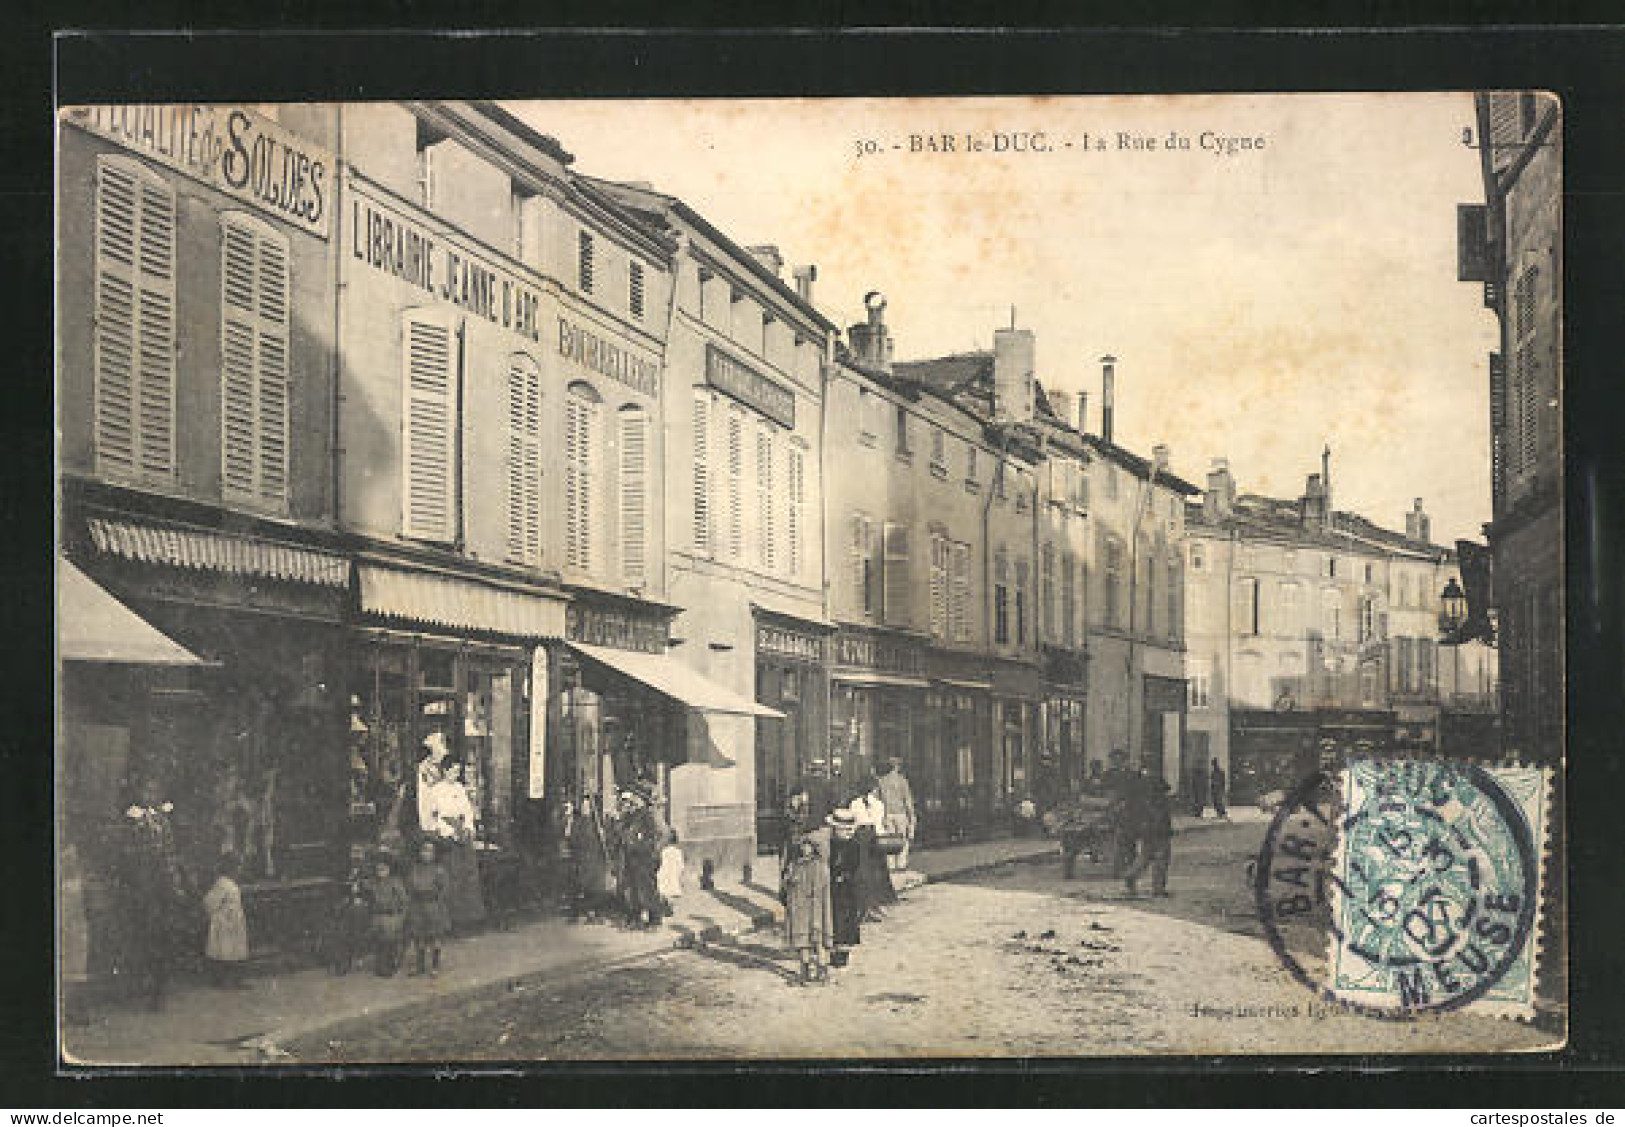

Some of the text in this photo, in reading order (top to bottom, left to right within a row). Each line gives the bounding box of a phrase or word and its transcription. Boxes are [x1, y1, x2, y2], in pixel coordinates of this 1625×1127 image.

[353, 201, 433, 292] LIBRAIRIE
[443, 251, 497, 323] JEANNE
[1397, 894, 1520, 1007] MEUSE
